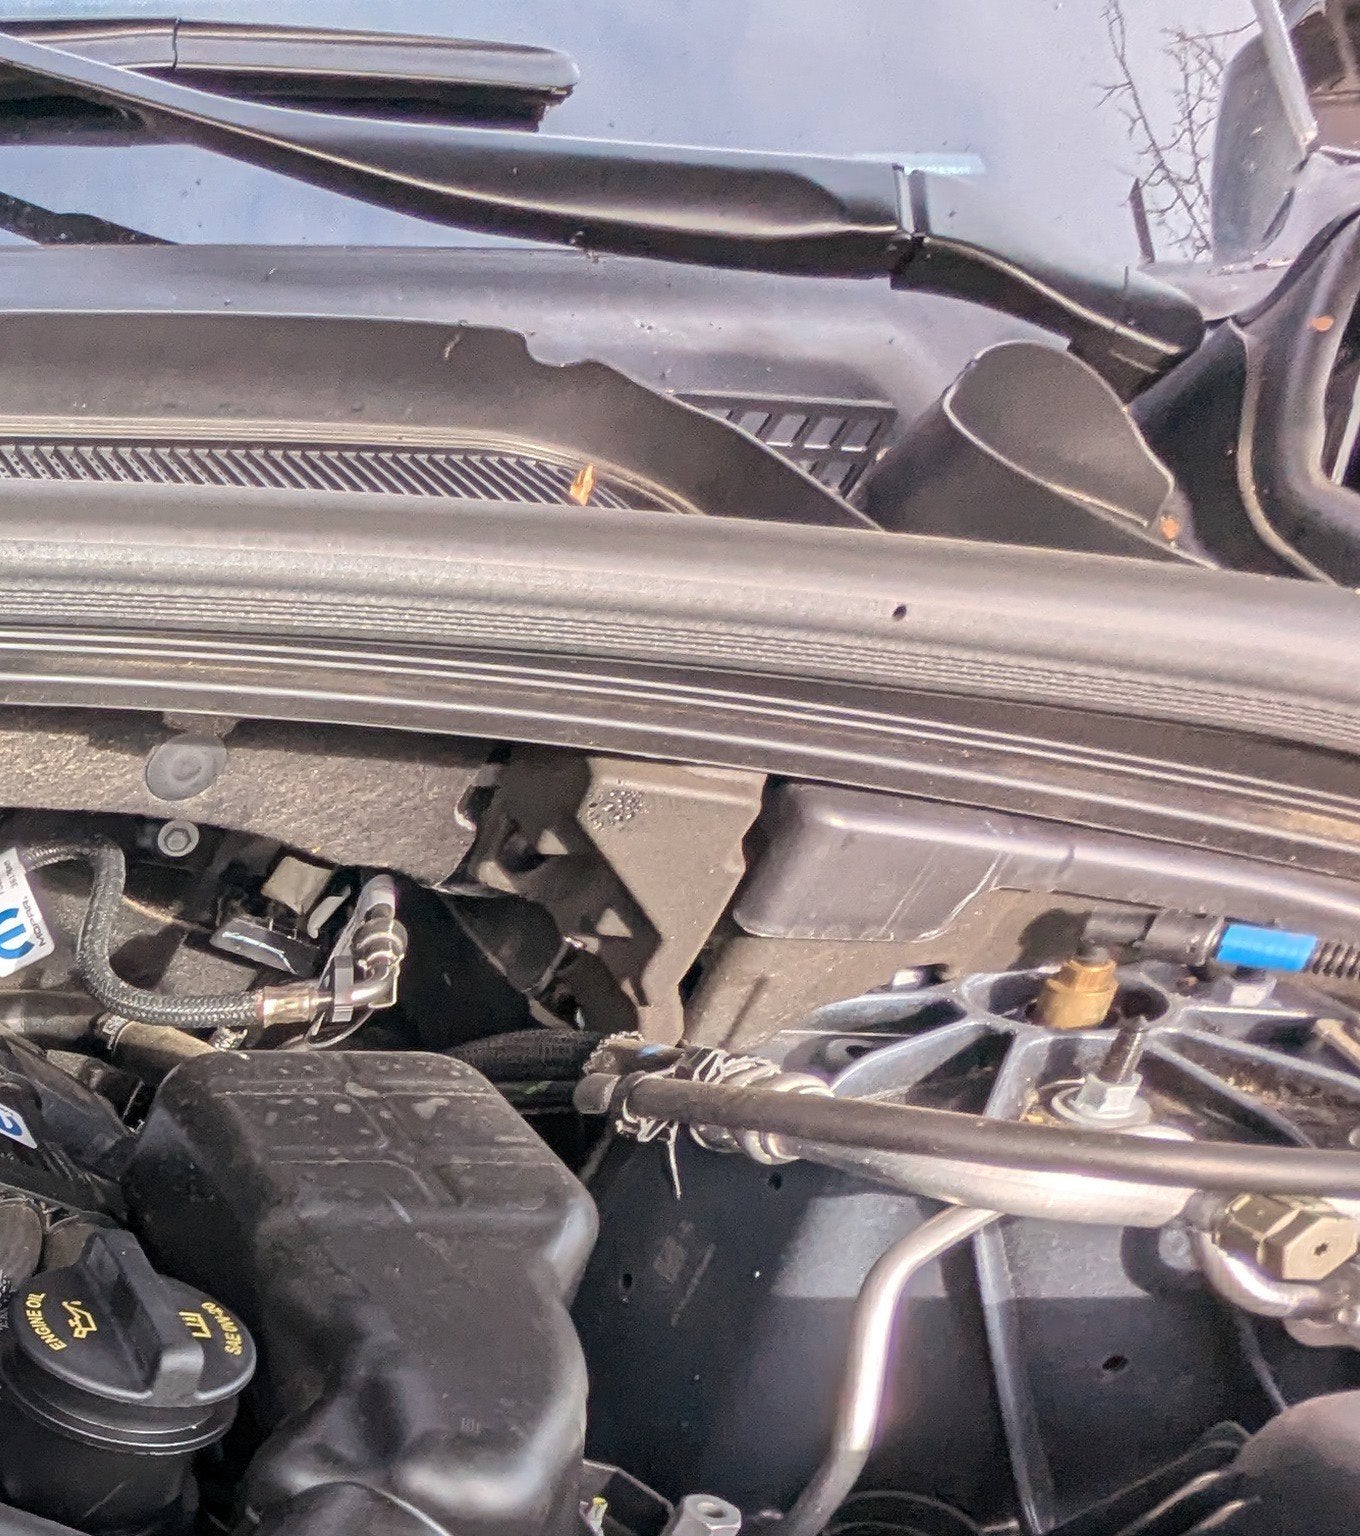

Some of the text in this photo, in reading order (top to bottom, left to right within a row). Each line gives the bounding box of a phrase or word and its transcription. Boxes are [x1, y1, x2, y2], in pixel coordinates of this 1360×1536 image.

[25, 1292, 68, 1351] ENGINE OIL
[224, 1331, 242, 1356] SAE
